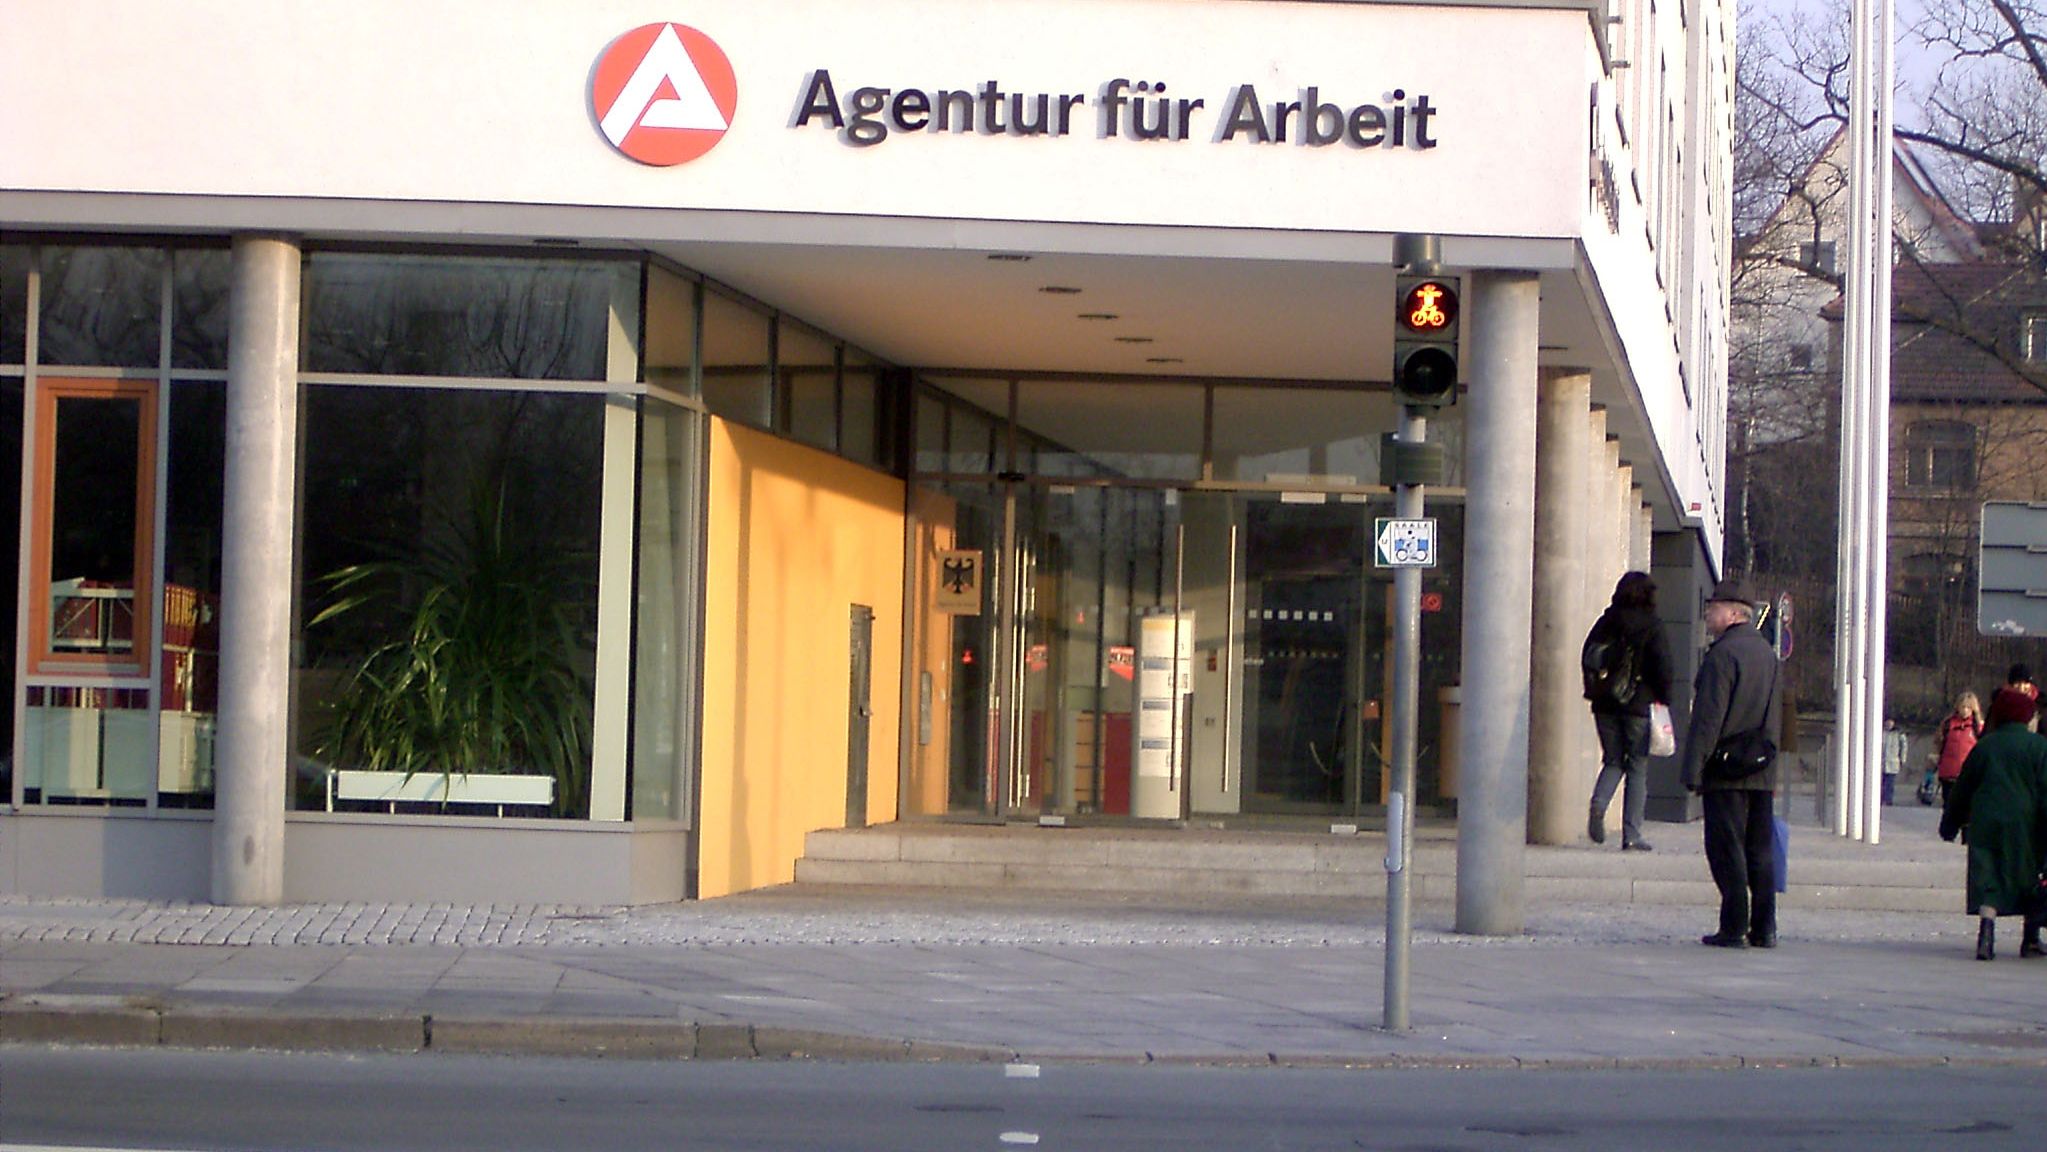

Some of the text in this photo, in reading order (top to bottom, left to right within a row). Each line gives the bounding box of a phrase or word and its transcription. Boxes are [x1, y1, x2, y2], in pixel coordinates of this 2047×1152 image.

[795, 68, 1437, 149] Agentur für Arbeit
